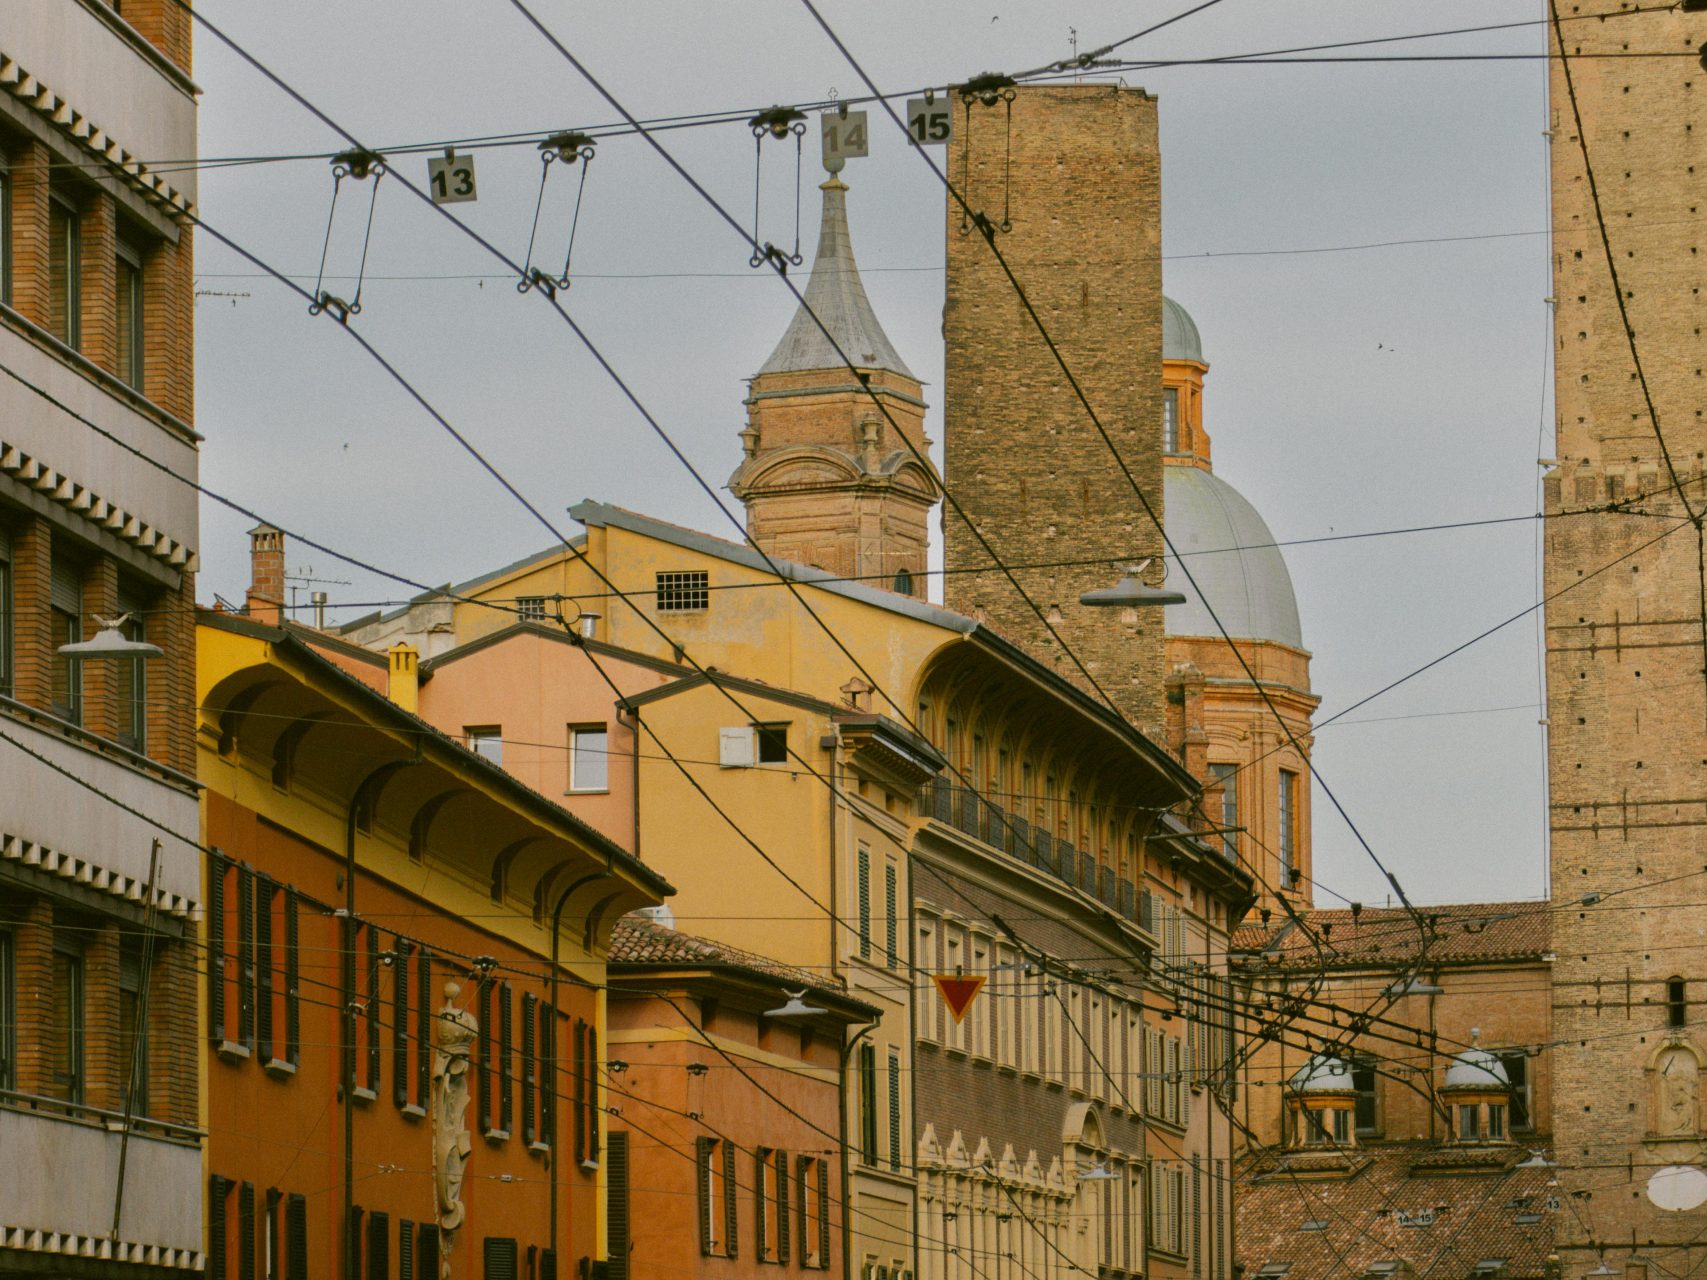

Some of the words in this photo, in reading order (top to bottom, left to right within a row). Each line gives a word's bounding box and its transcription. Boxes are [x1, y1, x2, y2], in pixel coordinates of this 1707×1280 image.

[822, 124, 866, 154] 14
[909, 112, 952, 142] 15
[430, 167, 475, 198] 13
[1547, 1200, 1560, 1209] 13
